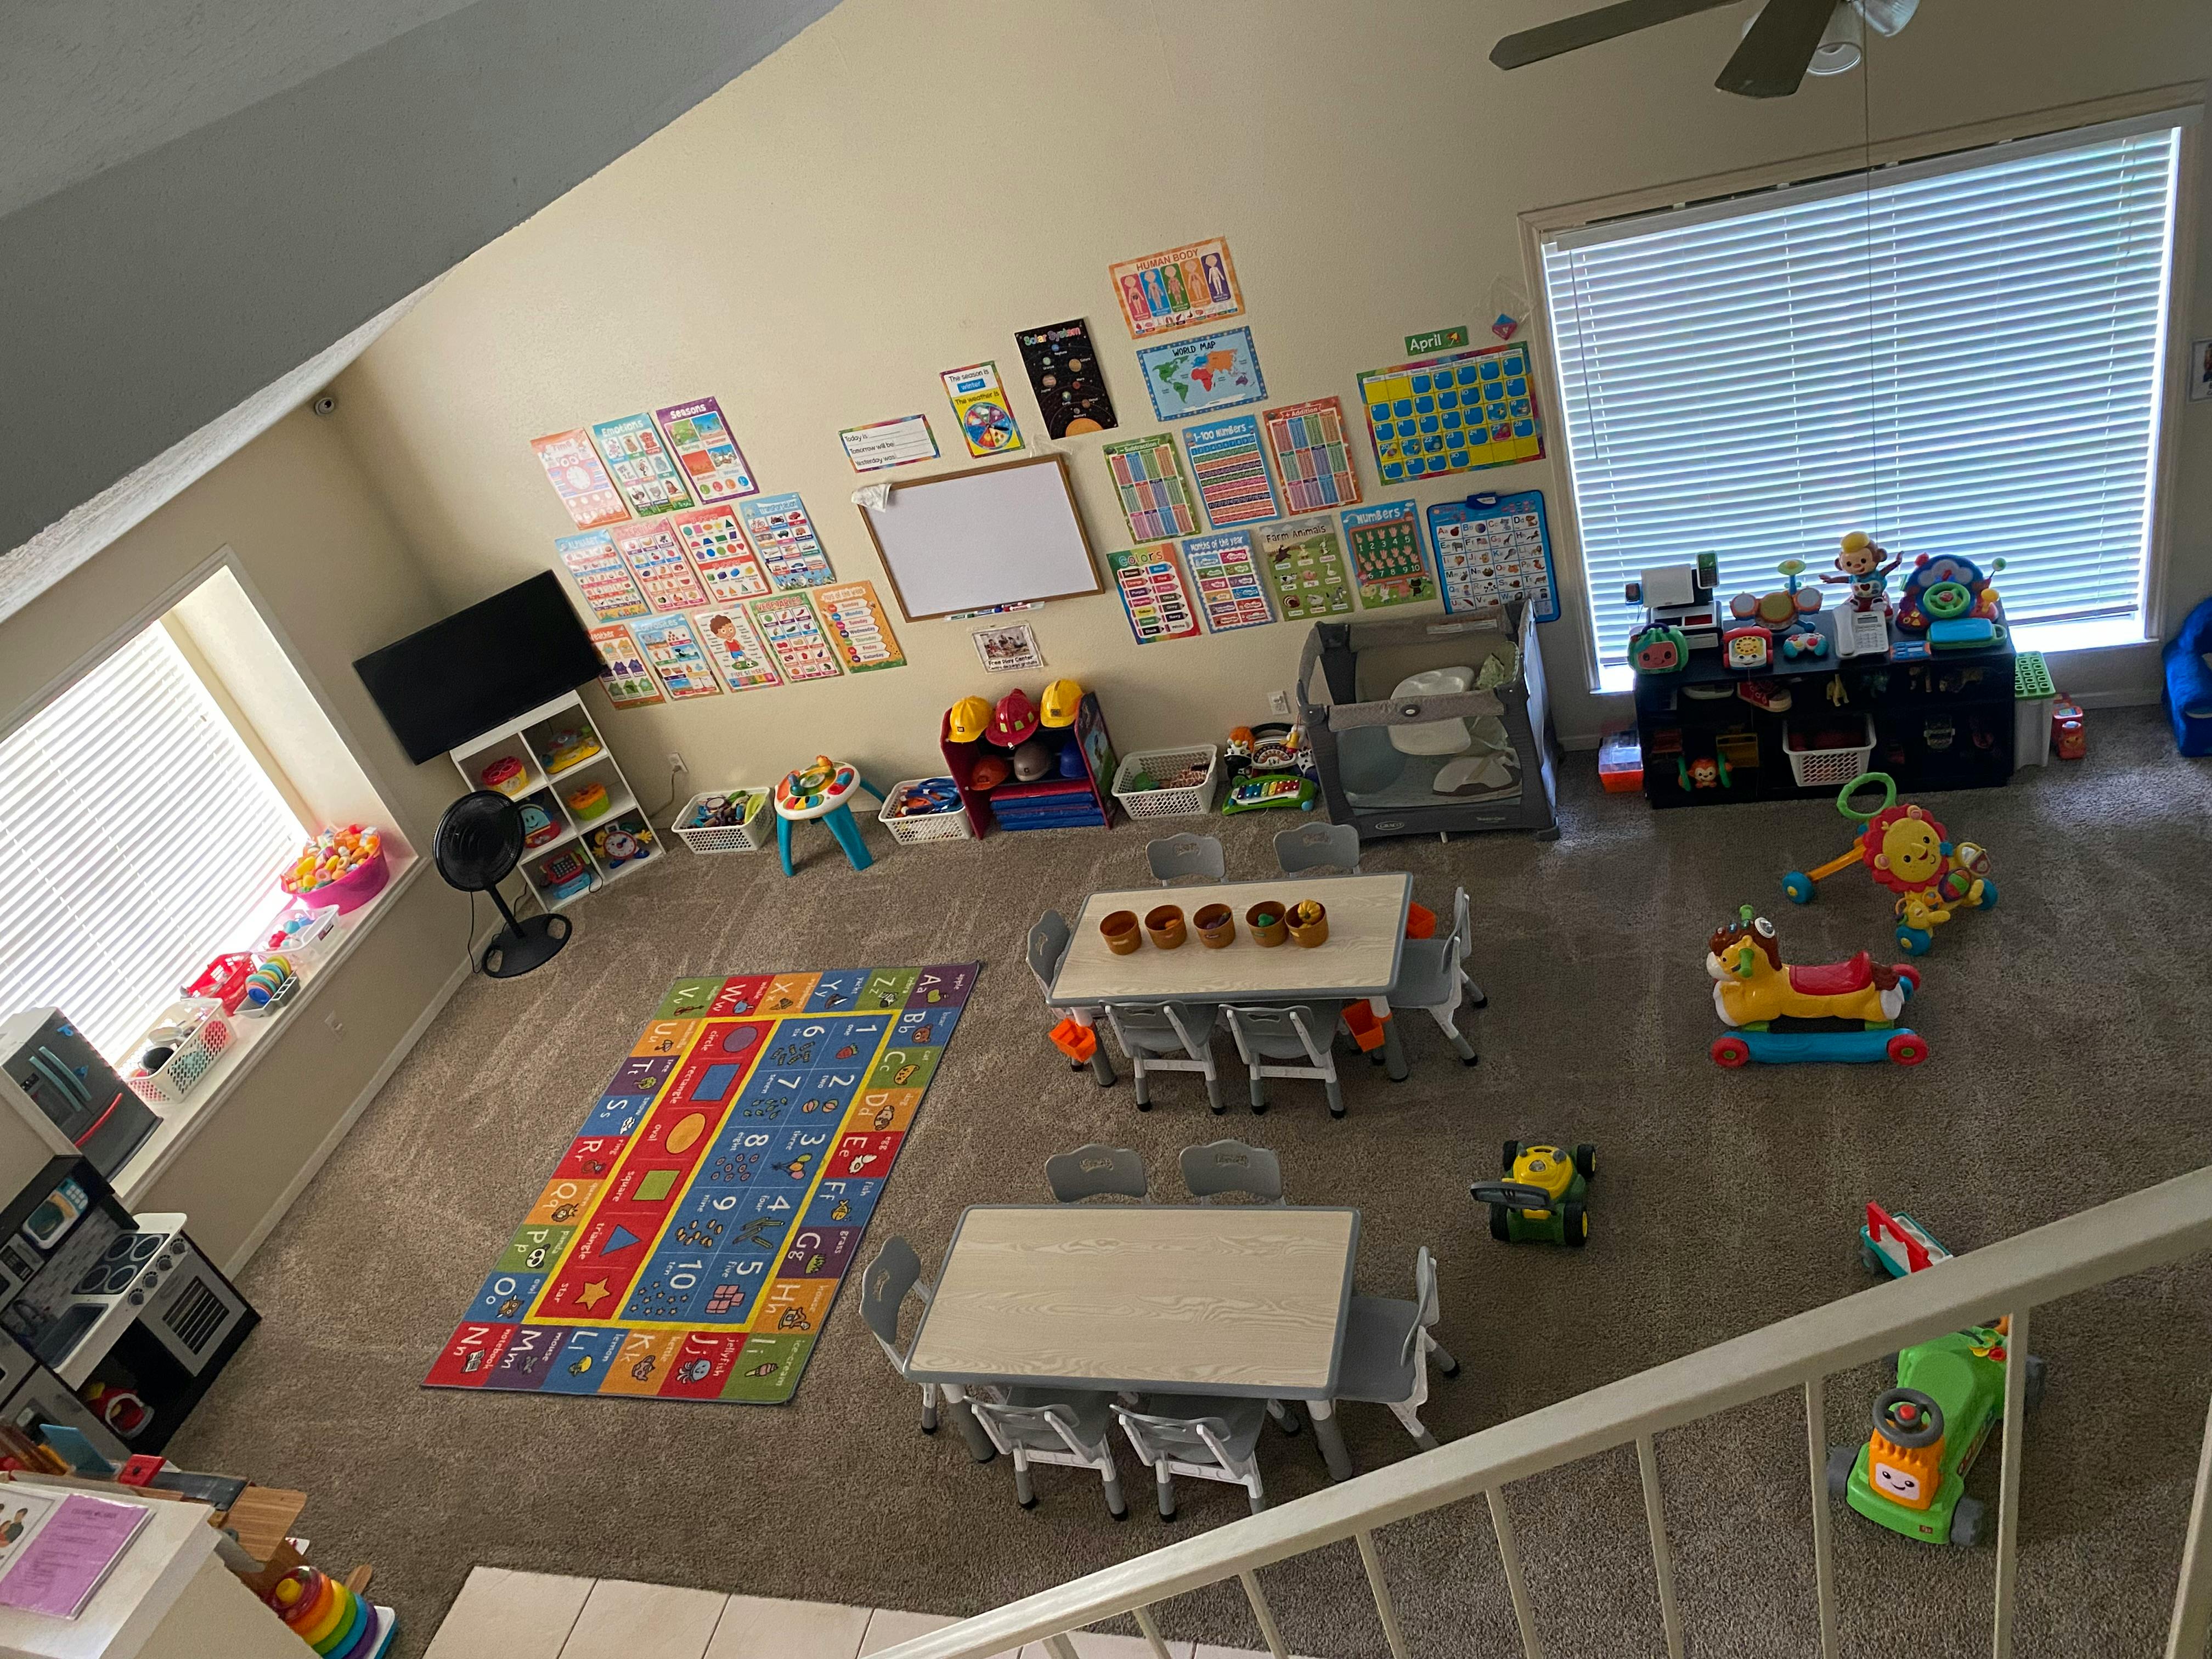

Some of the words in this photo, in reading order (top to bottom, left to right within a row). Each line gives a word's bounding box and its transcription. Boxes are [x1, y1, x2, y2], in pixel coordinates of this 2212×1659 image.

[1137, 257, 1171, 271] HUMAN
[1173, 249, 1198, 261] BODY
[1024, 335, 1047, 346] Solar
[1047, 328, 1081, 341] System
[1410, 334, 1442, 352] April
[1172, 346, 1196, 356] WORLD
[1200, 341, 1215, 351] MAP
[961, 371, 983, 380] season
[961, 381, 981, 390] winter
[968, 393, 992, 402] weather
[670, 404, 707, 419] Seasons
[1292, 408, 1318, 416] Addition
[601, 420, 643, 437] Emotions
[1193, 431, 1214, 442] 1-100
[553, 441, 572, 450] Time
[849, 446, 876, 454] Tomorrow
[1125, 442, 1157, 452] Subtraction
[855, 458, 883, 466] Yesterday
[1266, 532, 1289, 543] Farm
[1293, 526, 1326, 538] Animals
[1190, 541, 1210, 550] Months
[1212, 540, 1218, 548] of
[1219, 538, 1229, 546] the
[1230, 537, 1243, 545] year
[756, 597, 803, 611] VEGETABLES
[851, 977, 865, 994] yacht
[902, 977, 915, 994] zebra
[954, 974, 964, 990] apple
[754, 981, 767, 999] whale
[939, 1012, 951, 1026] bear
[803, 1026, 825, 1037] 6
[844, 1024, 854, 1036] one
[701, 1031, 717, 1051] circle
[662, 1059, 674, 1073] tree
[670, 1066, 697, 1104] rectangle
[761, 1074, 776, 1093] seven
[777, 1076, 801, 1088] 7
[818, 1075, 828, 1088] two
[828, 1075, 854, 1087] 2
[647, 1124, 661, 1141] oval
[800, 1133, 825, 1146] 3
[744, 1135, 769, 1147] 8
[786, 1131, 801, 1150] three
[879, 1137, 891, 1150] egg
[613, 1171, 635, 1201] square
[860, 1182, 874, 1196] fish
[697, 1194, 710, 1212] nine
[713, 1197, 736, 1210] 9
[756, 1195, 770, 1211] four
[767, 1196, 790, 1211] 4
[552, 1231, 570, 1254] panda
[579, 1223, 605, 1260] triangle
[834, 1231, 849, 1254] grass
[664, 1261, 675, 1276] ten
[670, 1260, 702, 1289] 10
[722, 1261, 737, 1278] five
[736, 1262, 763, 1275] 5
[528, 1279, 540, 1294] owl
[555, 1283, 569, 1303] star
[483, 1329, 511, 1369] notebook
[543, 1332, 563, 1362] mouse
[602, 1333, 624, 1361] lemon
[713, 1338, 739, 1376] jellyfish
[776, 1340, 805, 1386] ice-cream
